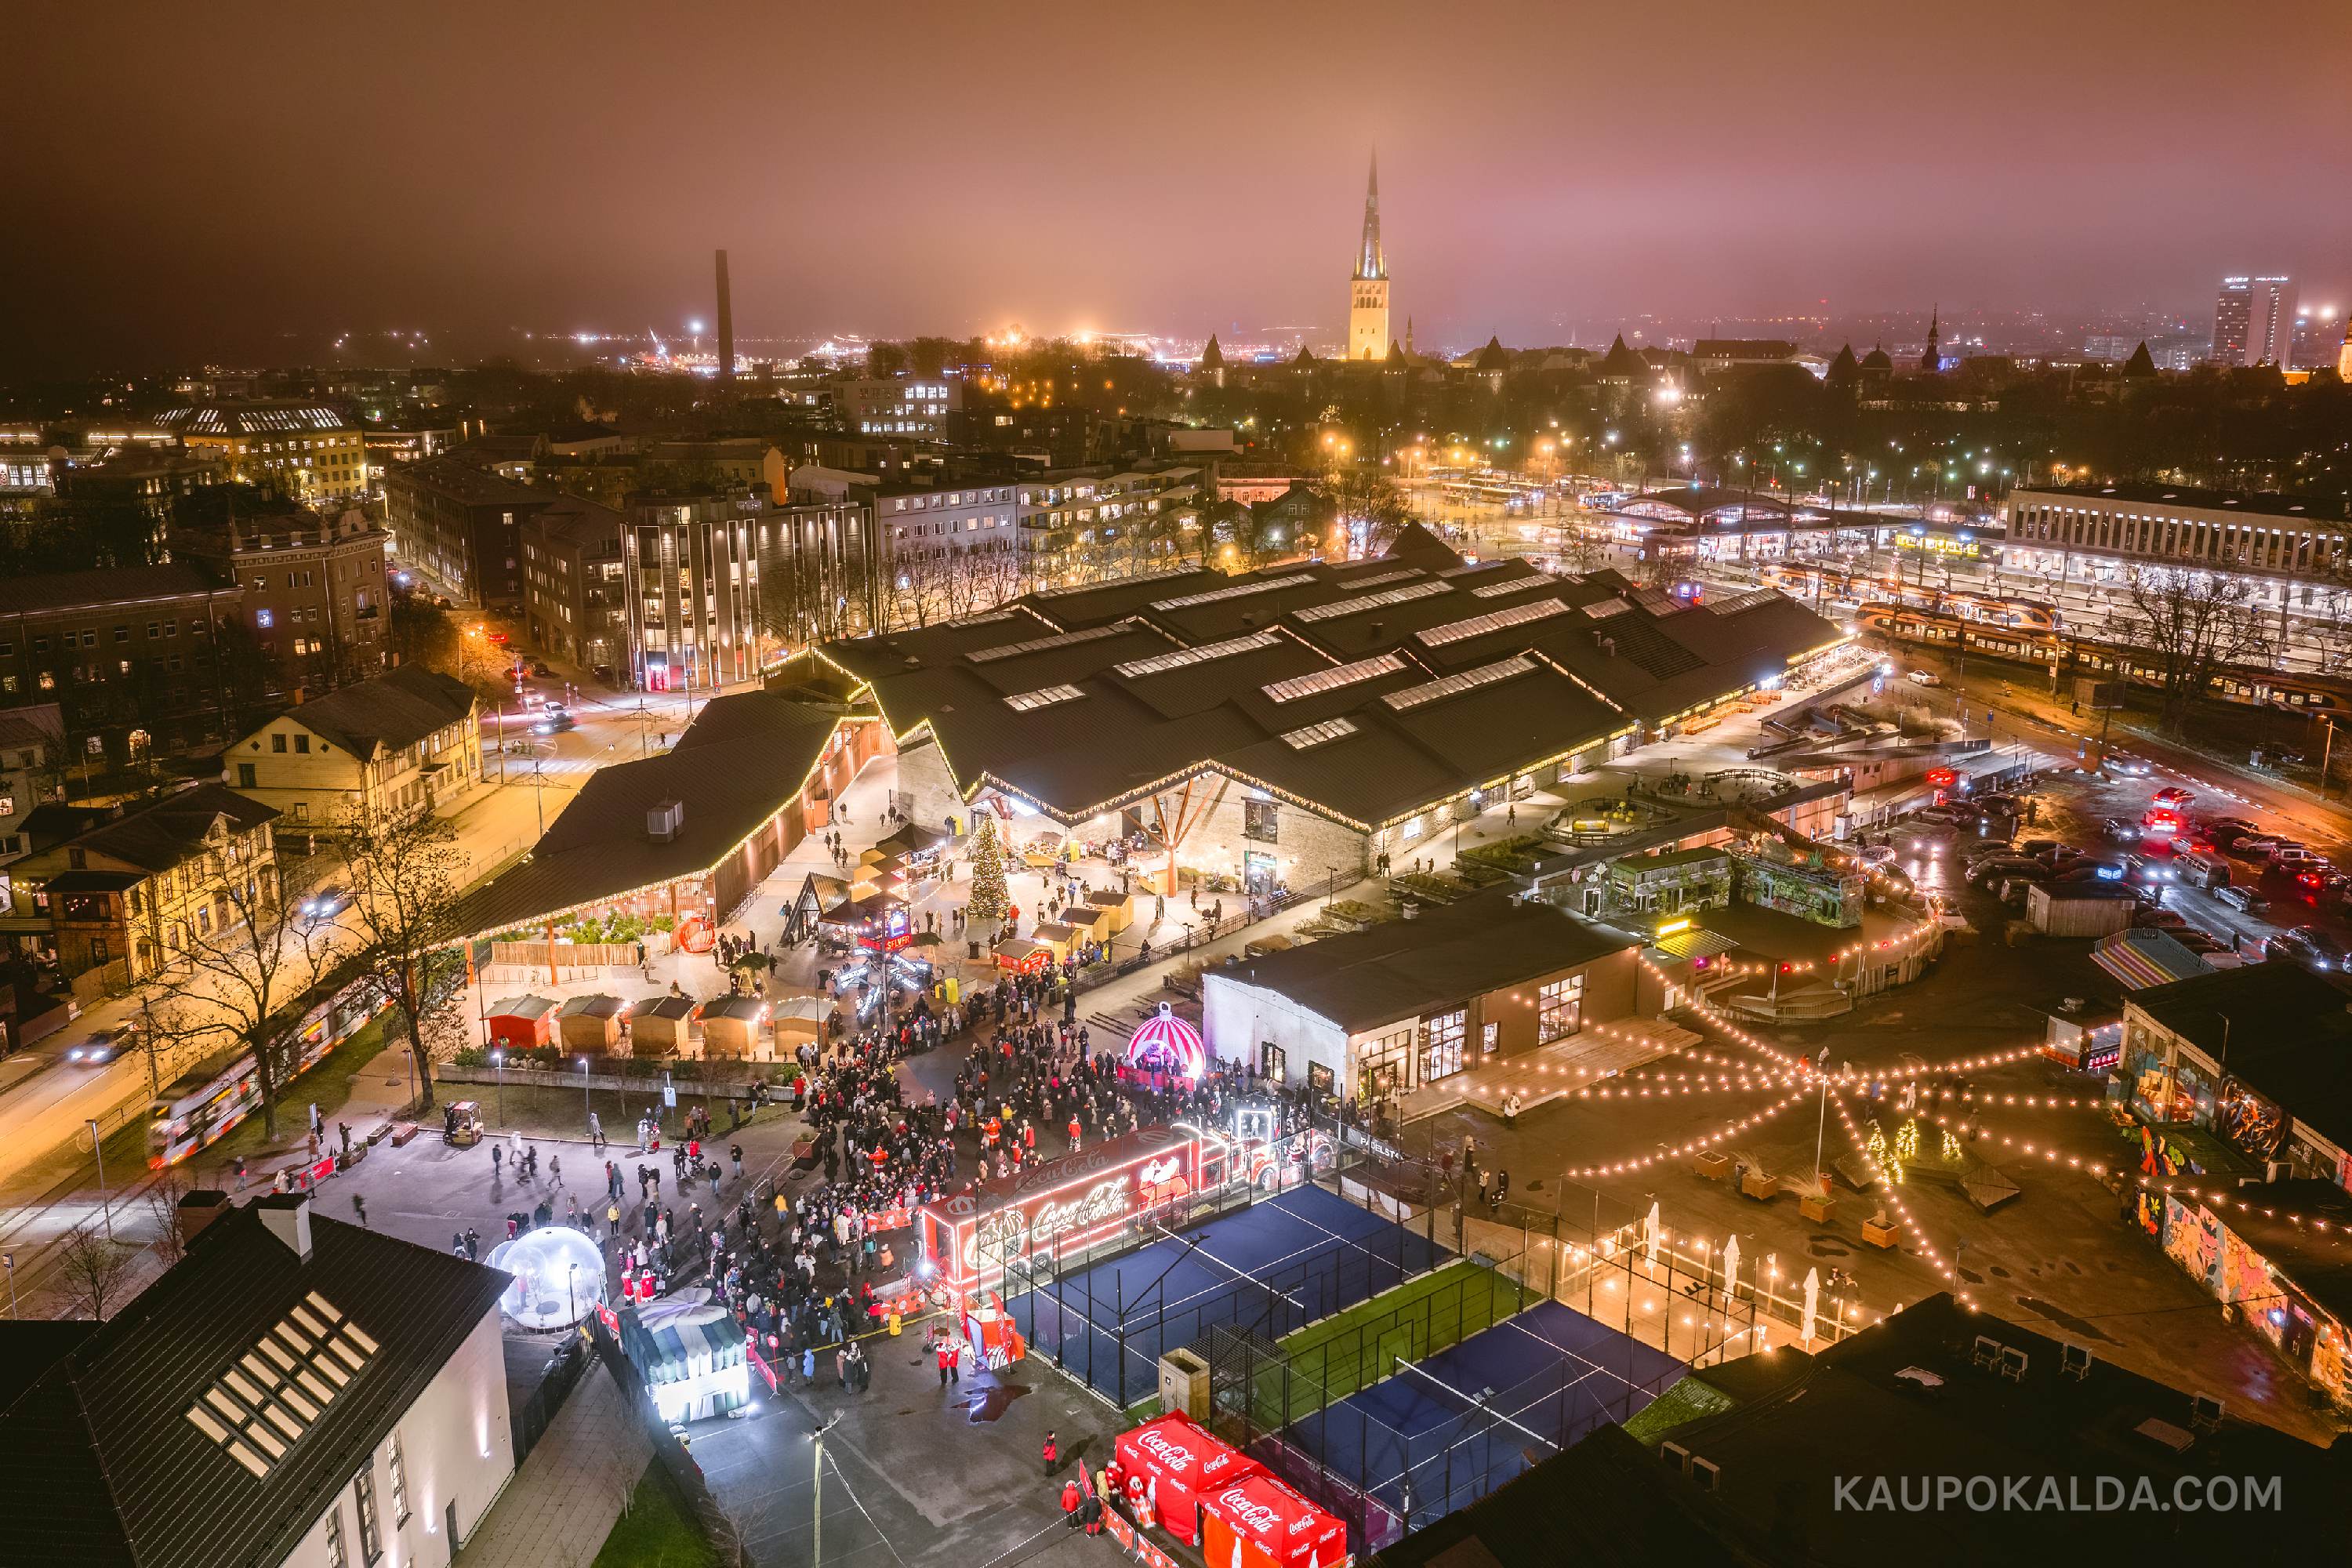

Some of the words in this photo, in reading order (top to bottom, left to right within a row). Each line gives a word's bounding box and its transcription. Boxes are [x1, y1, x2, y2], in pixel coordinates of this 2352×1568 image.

[887, 935, 910, 949] SELVER
[1138, 1430, 1196, 1471] Coca-Cola
[1204, 1454, 1229, 1473] Coca-Cola
[1220, 1489, 1283, 1534] Coca-Cola
[1290, 1514, 1315, 1534] Coca-Cola
